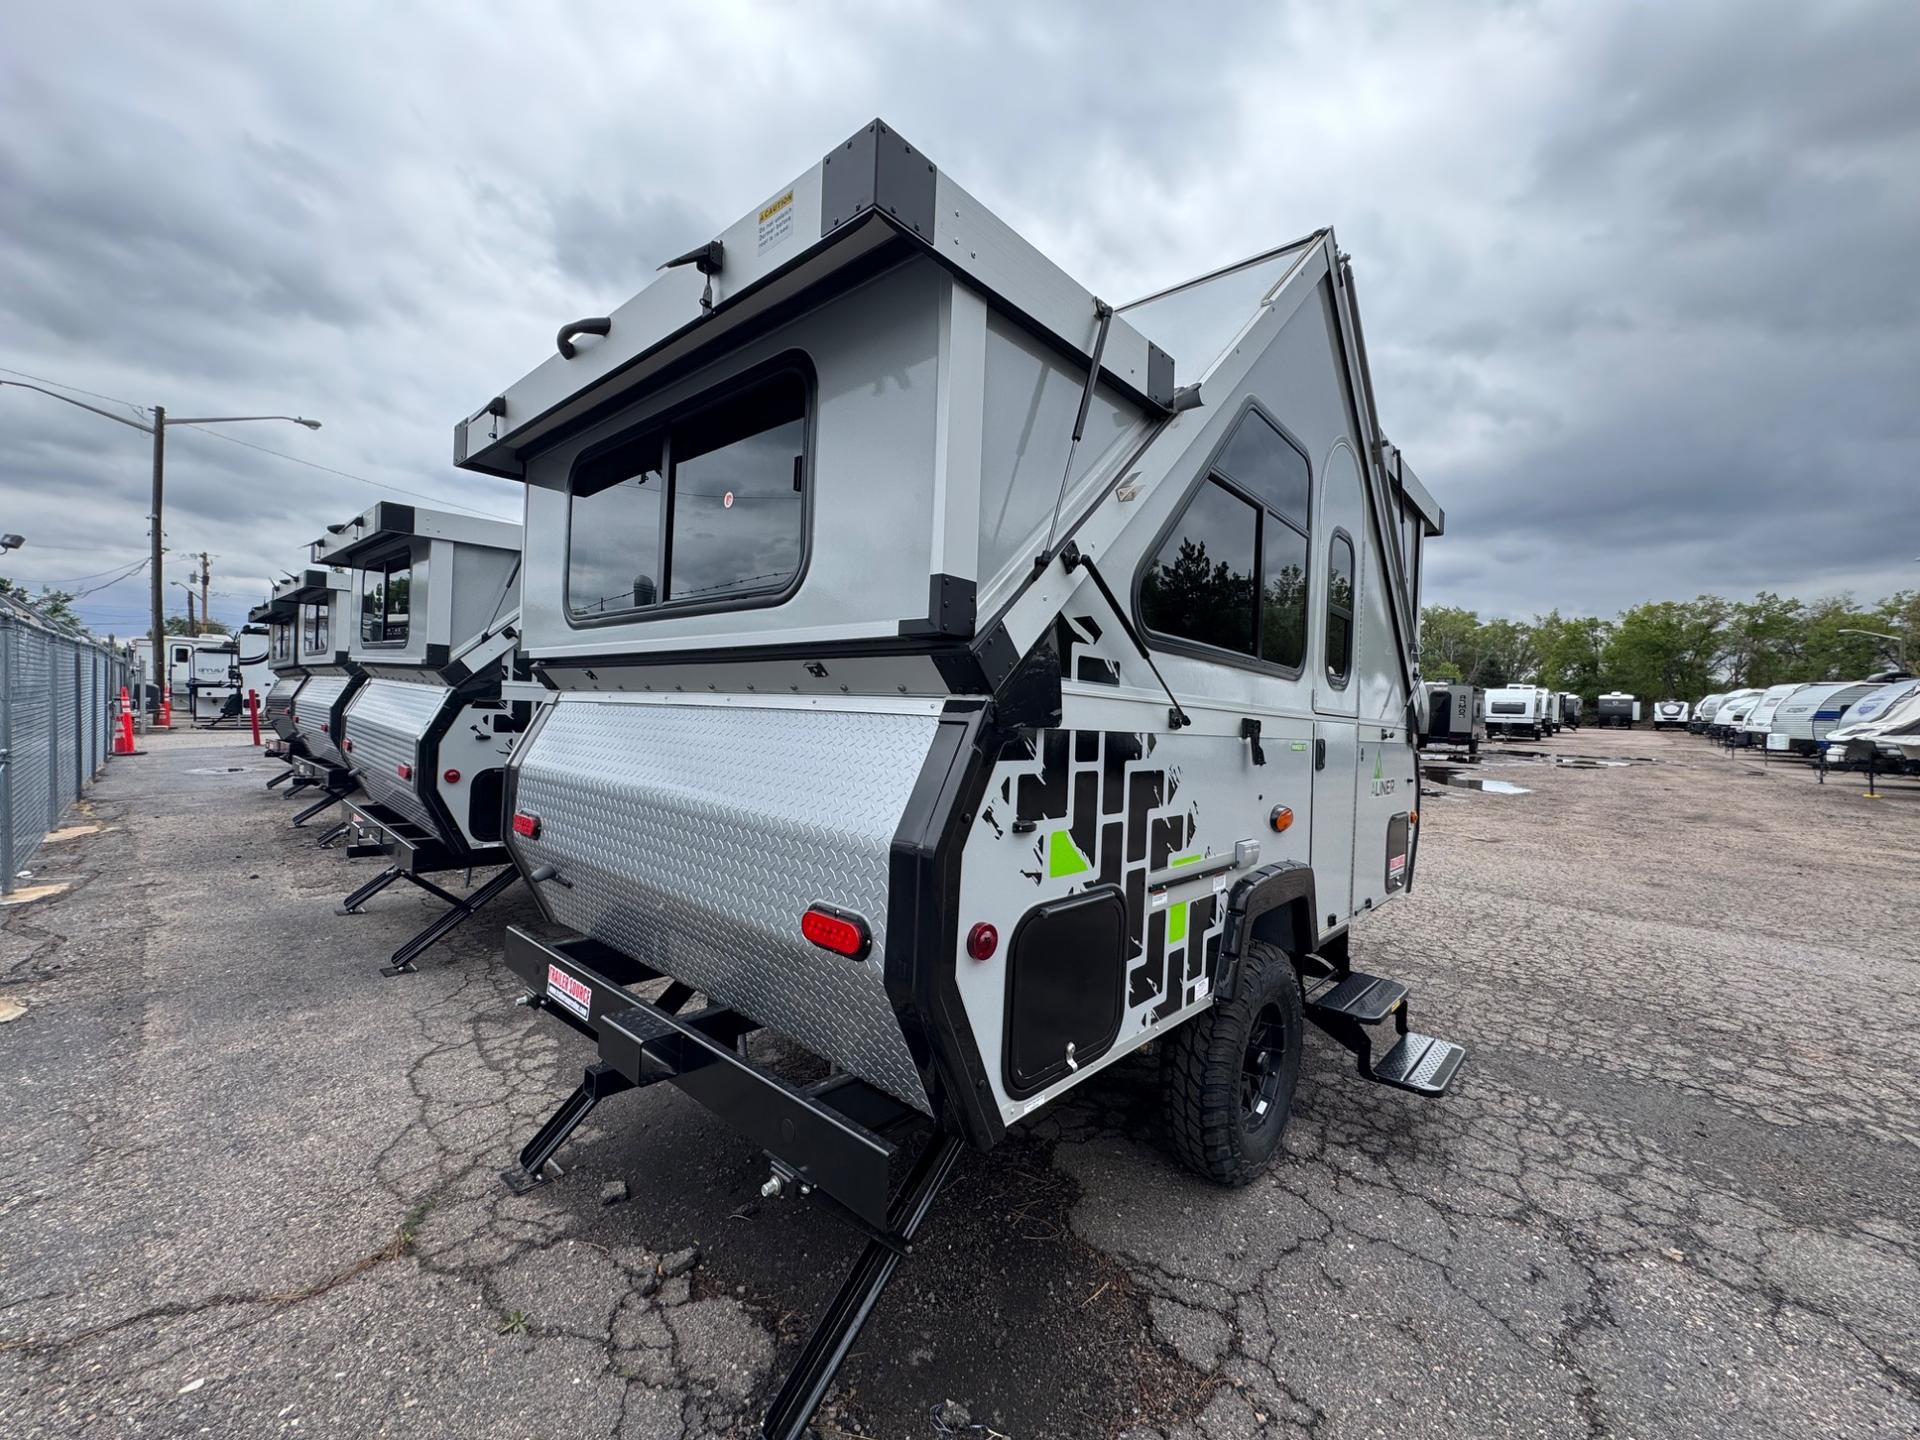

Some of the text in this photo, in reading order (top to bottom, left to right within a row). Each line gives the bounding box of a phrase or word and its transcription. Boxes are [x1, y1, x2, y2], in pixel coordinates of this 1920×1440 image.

[765, 191, 793, 217] CAUTION
[549, 965, 570, 993] TRAILER
[569, 978, 591, 1007] SOURCE
